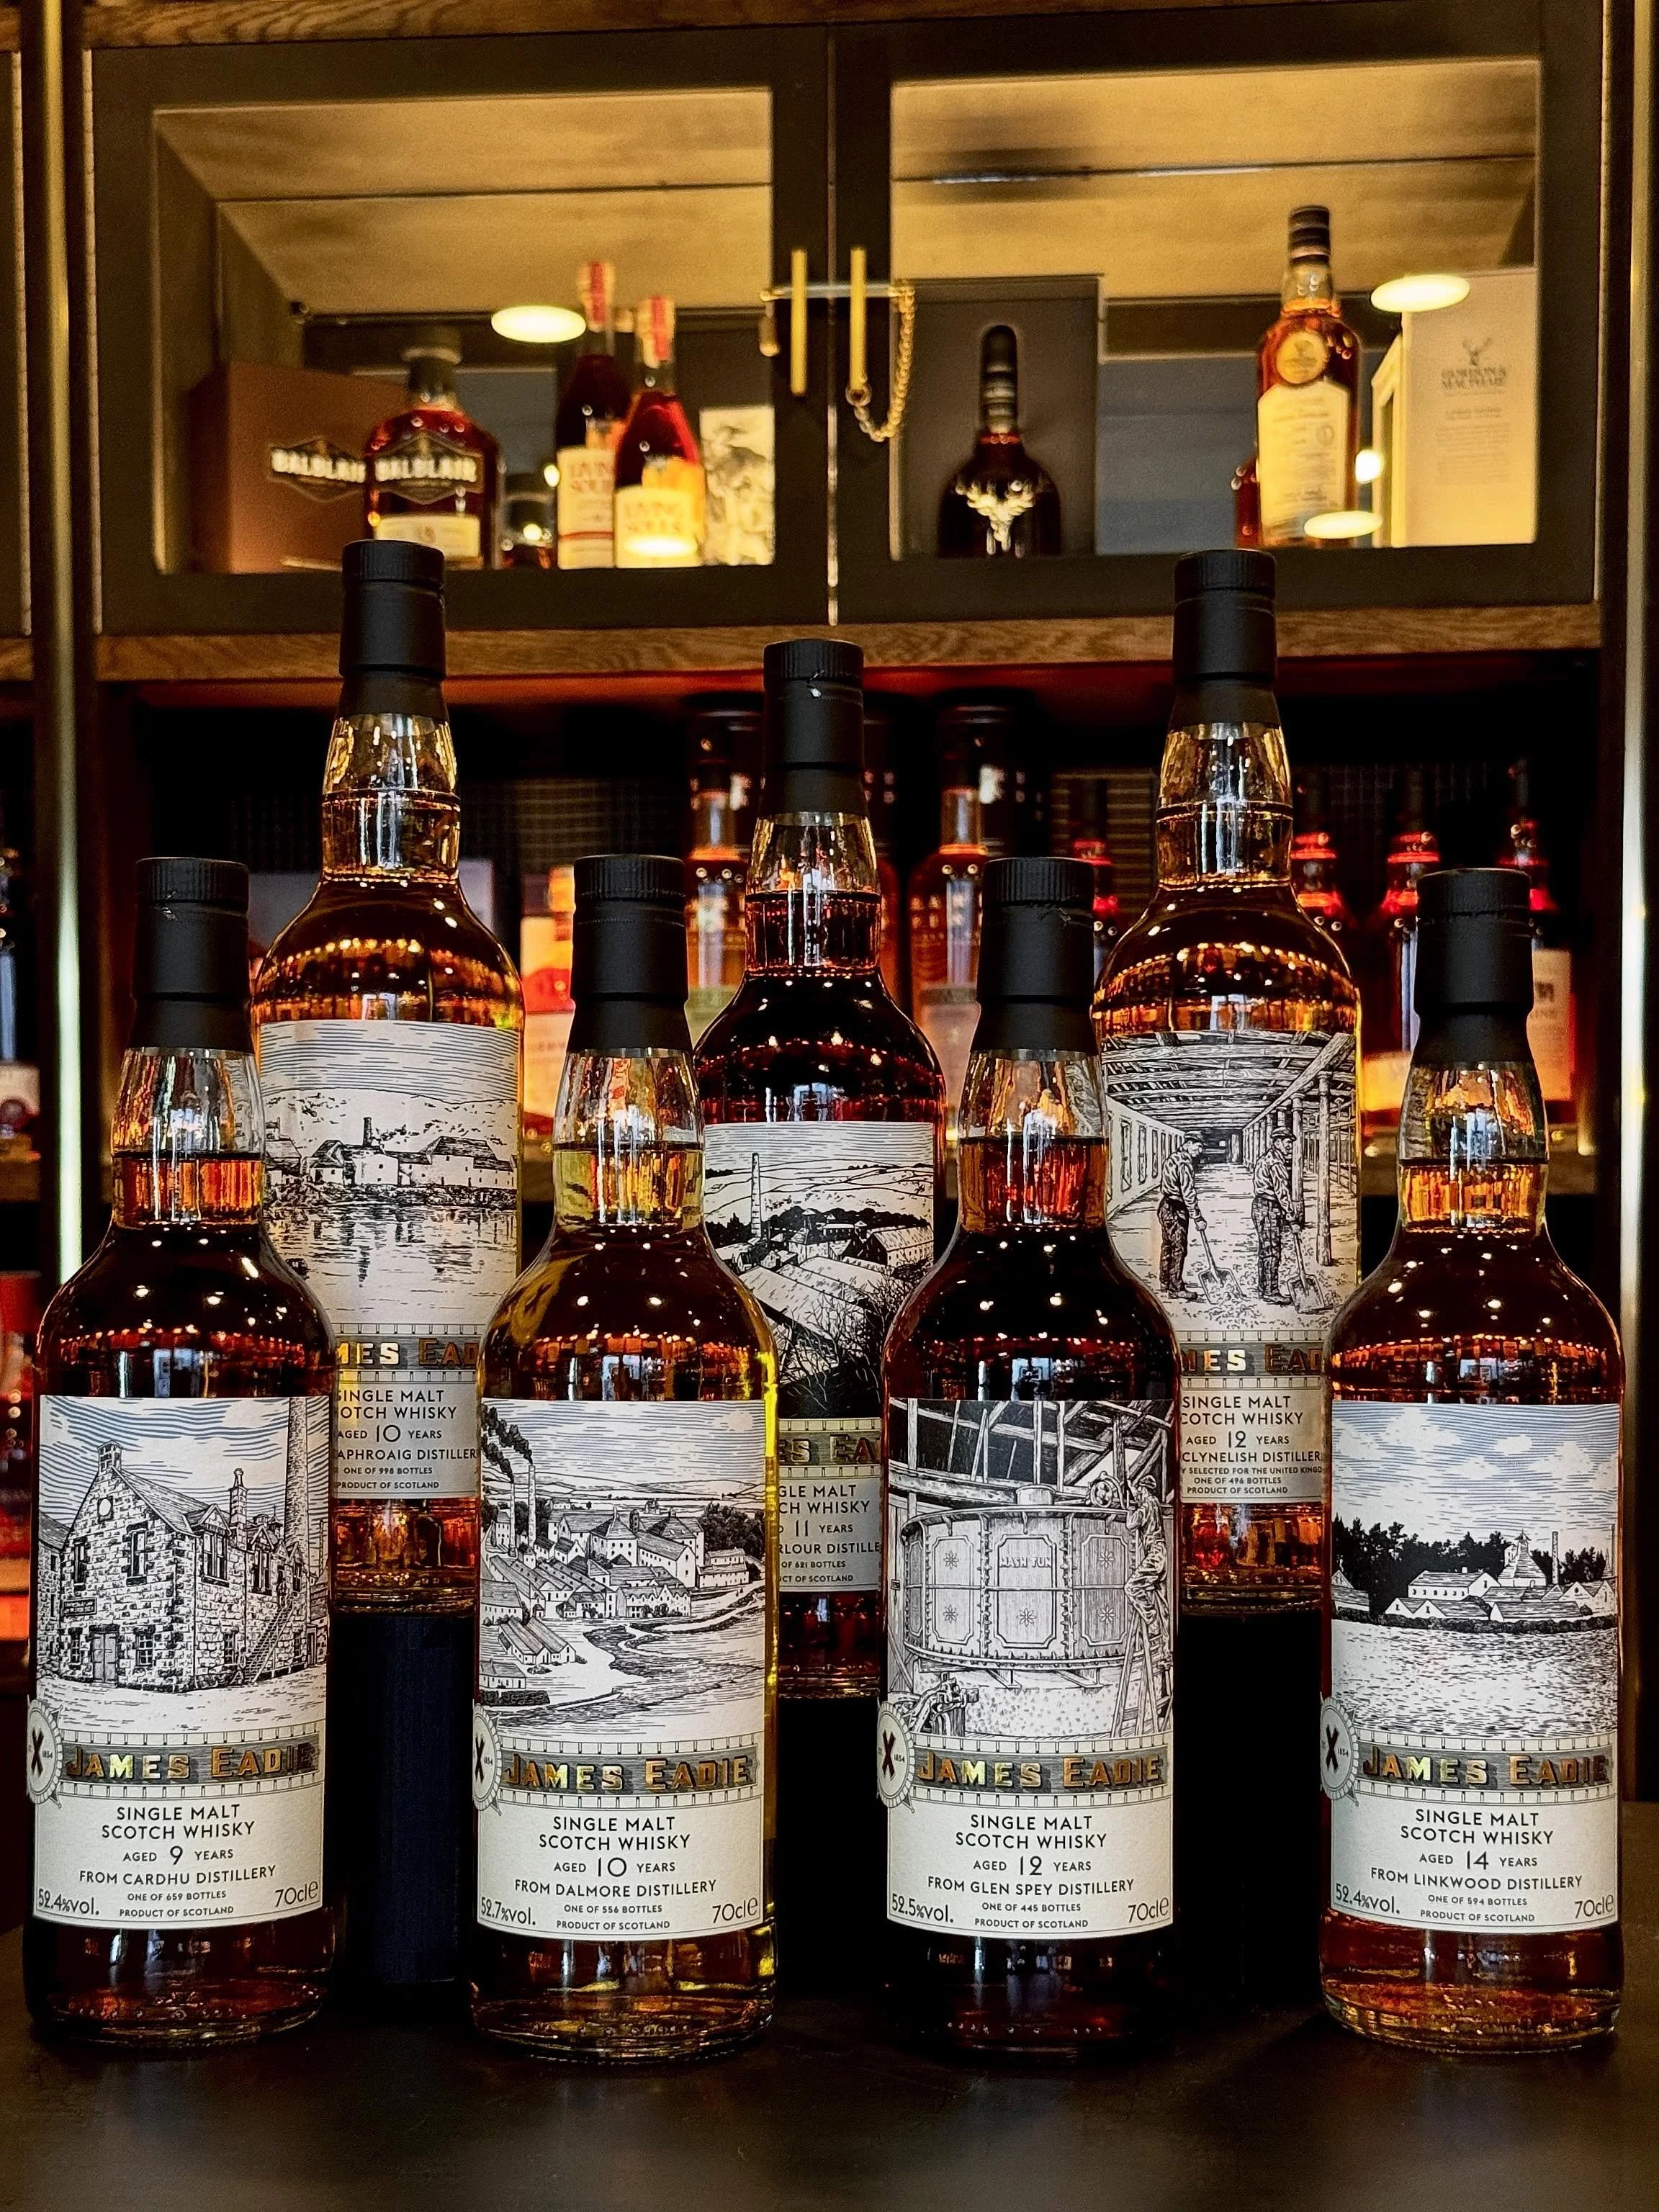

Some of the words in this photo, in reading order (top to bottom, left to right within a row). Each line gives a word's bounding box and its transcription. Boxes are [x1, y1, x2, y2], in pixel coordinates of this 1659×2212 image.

[418, 1338, 479, 1365] EAD
[1265, 1344, 1322, 1372] EAD
[401, 1390, 444, 1403] MALT
[1182, 1396, 1241, 1408] SINGLE
[1249, 1395, 1291, 1408] MALT
[341, 1406, 386, 1419] OTCH
[395, 1406, 457, 1419] WHISKY
[1182, 1413, 1234, 1425] COTCH
[1242, 1412, 1303, 1425] WHISKY
[376, 1424, 400, 1442] 10
[408, 1430, 442, 1439] YEARS
[1186, 1436, 1216, 1445] AGED
[1228, 1431, 1246, 1448] 12
[1256, 1436, 1290, 1444] YEARS
[338, 1450, 412, 1460] APHROAIG
[418, 1449, 476, 1460] DISTILLER
[1182, 1452, 1256, 1462] CLYNELISH
[1263, 1451, 1320, 1462] DISTILLER
[779, 1485, 806, 1497] GLE
[814, 1485, 856, 1497] MALT
[807, 1501, 871, 1513] WHISKY
[778, 1544, 821, 1554] RLOUR
[827, 1542, 879, 1553] DISTILLE
[32, 1727, 44, 1777] X
[882, 1729, 896, 1780] X
[1326, 1724, 1339, 1773] X
[67, 1745, 190, 1780] JAMES
[210, 1742, 316, 1777] EADIE
[475, 1734, 485, 1783] X
[1363, 1747, 1488, 1784] JAMES
[1509, 1754, 1607, 1786] EADIE
[505, 1753, 623, 1791] JAMES
[645, 1755, 748, 1791] EADIE
[917, 1751, 1043, 1786] JAMES
[1062, 1754, 1160, 1788] EADIE
[117, 1807, 182, 1820] SINGLE
[191, 1804, 240, 1820] MALT
[1416, 1809, 1482, 1825] SINGLE
[1491, 1813, 1539, 1826] MALT
[102, 1825, 174, 1839] SCOTCH
[183, 1821, 254, 1838] WHISKY
[553, 1816, 617, 1831] SINGLE
[626, 1817, 675, 1831] MALT
[971, 1815, 1035, 1830] SINGLE
[1044, 1816, 1092, 1830] MALT
[539, 1834, 609, 1851] SCOTCH
[618, 1834, 690, 1851] WHISKY
[956, 1832, 1028, 1849] SCOTCH
[1037, 1833, 1106, 1849] WHISKY
[1401, 1826, 1474, 1843] SCOTCH
[1483, 1831, 1553, 1845] WHISKY
[122, 1852, 157, 1861] AGED
[170, 1845, 183, 1865] 9
[194, 1849, 233, 1861] YEARS
[1419, 1853, 1453, 1864] AGED
[1467, 1851, 1489, 1870] 14
[1499, 1857, 1537, 1866] YEARS
[554, 1862, 586, 1872] AGED
[598, 1857, 626, 1877] 10
[637, 1862, 675, 1873] YEARS
[974, 1861, 1007, 1871] AGED
[1020, 1856, 1042, 1875] 12
[1053, 1861, 1091, 1871] YEARS
[80, 1871, 117, 1884] FROM
[123, 1873, 189, 1885] CARDHU
[197, 1865, 276, 1884] DISTILLERY
[1371, 1867, 1408, 1884] FROM
[1414, 1875, 1501, 1891] LINKWOOD
[1508, 1876, 1582, 1889] DISTILLERY
[516, 1879, 549, 1894] FROM
[556, 1884, 630, 1897] DALMORE
[637, 1879, 716, 1897] DISTILLERY
[928, 1876, 964, 1892] FROM
[971, 1881, 1009, 1894] GLEN
[1016, 1884, 1052, 1895] SPEY
[1059, 1879, 1133, 1895] DISTILLERY
[186, 1891, 226, 1900] BOTTLES
[120, 1909, 163, 1917] PRODUCT
[183, 1906, 233, 1916] SCOTLAND
[622, 1905, 662, 1913] BOTTLES
[1421, 1910, 1465, 1920] PRODUCT
[557, 1920, 600, 1930] PRODUCT
[619, 1921, 670, 1930] SCOTLAND
[975, 1918, 1019, 1928] PRODUCT
[1022, 1919, 1035, 1928] OF
[1038, 1920, 1088, 1928] SCOTLAND
